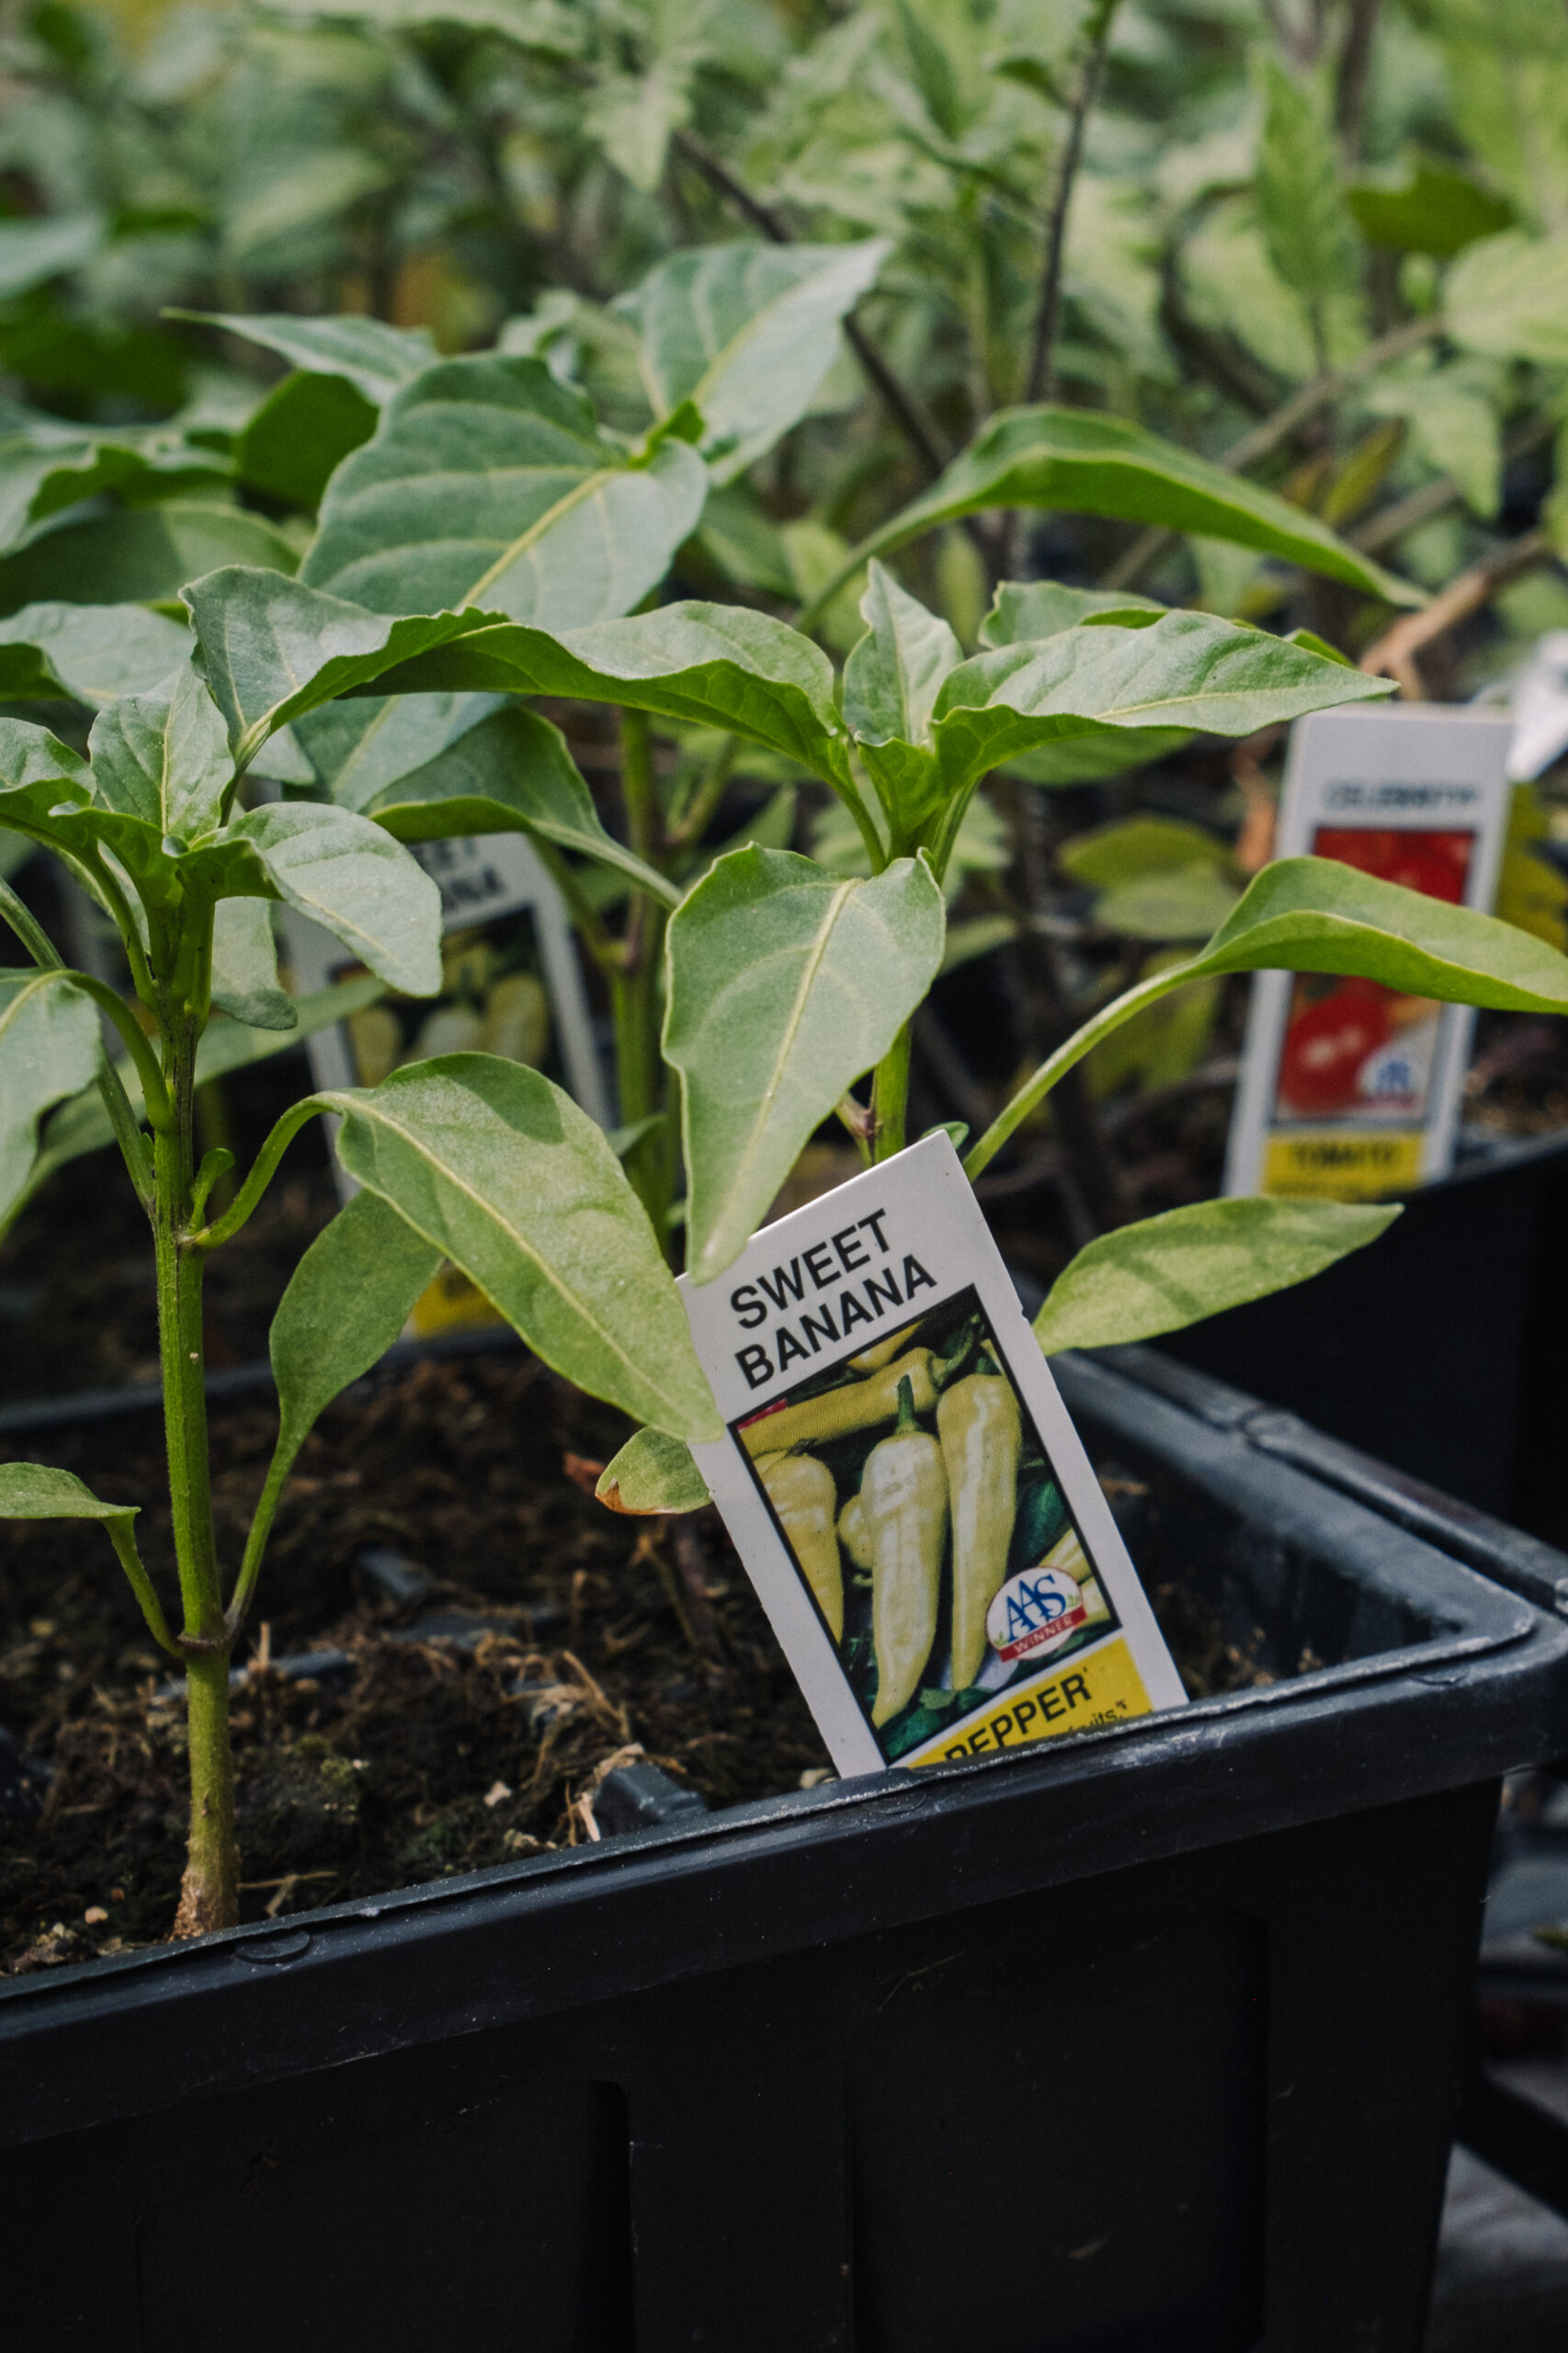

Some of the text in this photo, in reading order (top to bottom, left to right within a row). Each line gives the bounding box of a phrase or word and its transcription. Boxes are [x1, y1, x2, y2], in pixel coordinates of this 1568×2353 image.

[731, 1209, 890, 1328] SWEET
[734, 1255, 937, 1389] BANANA
[1006, 1574, 1067, 1643] AAS
[1013, 1615, 1074, 1654] WINNER
